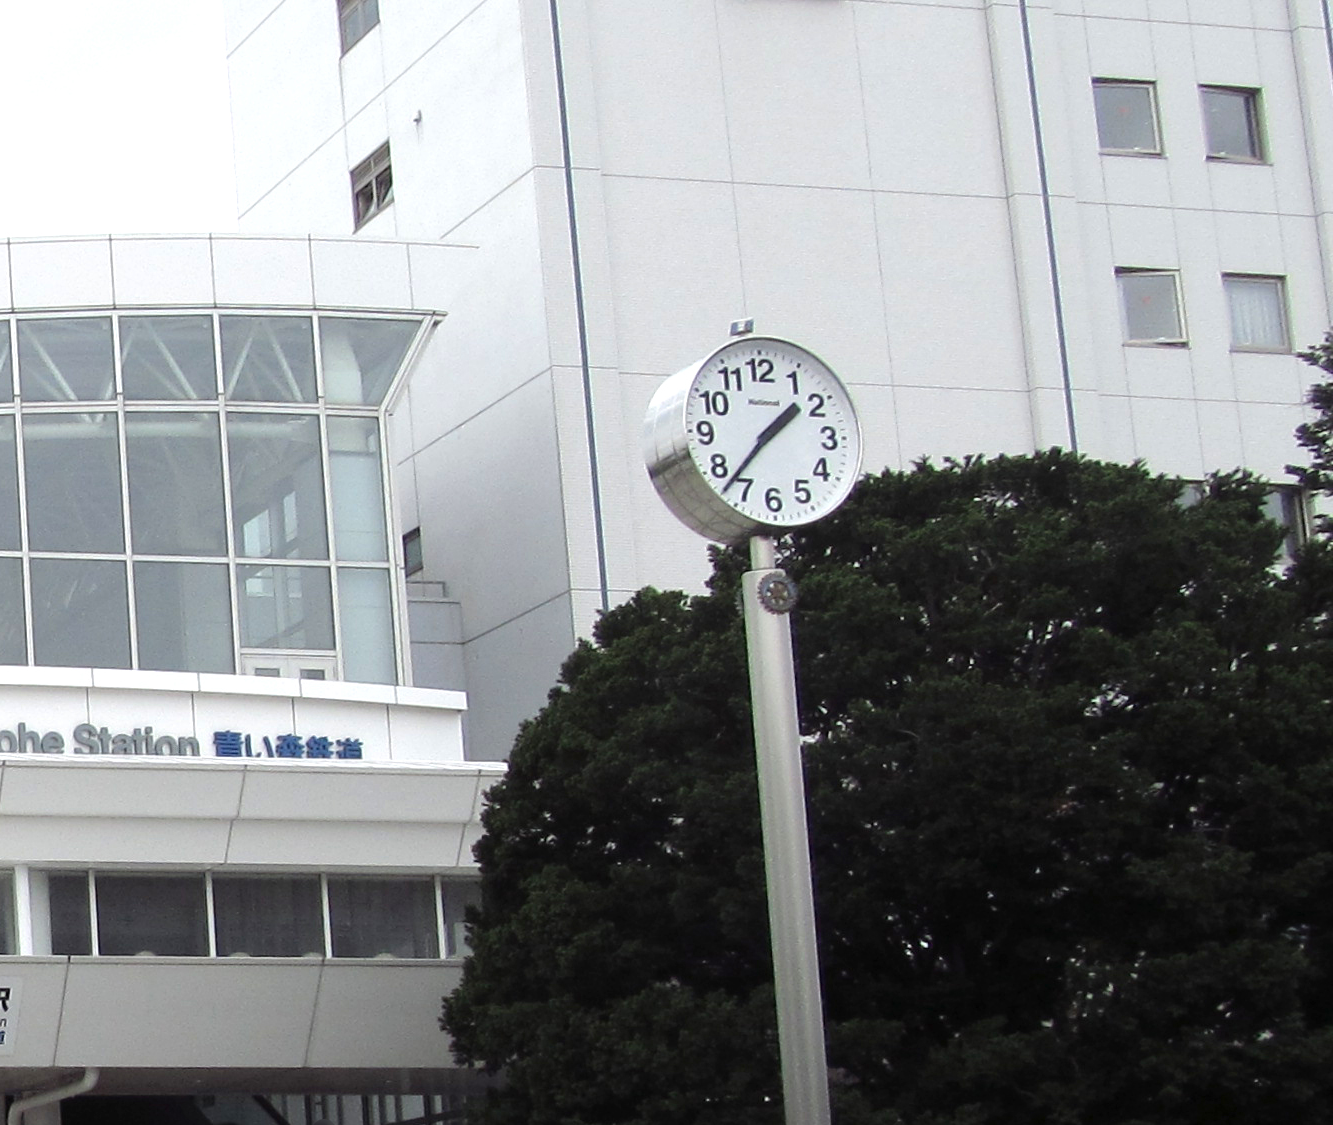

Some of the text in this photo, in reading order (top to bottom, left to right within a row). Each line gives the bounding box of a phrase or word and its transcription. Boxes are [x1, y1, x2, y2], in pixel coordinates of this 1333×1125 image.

[718, 367, 743, 391] 11
[745, 358, 775, 383] 12
[786, 371, 799, 395] 1
[699, 391, 729, 416] 10
[807, 394, 826, 418] 2
[696, 421, 715, 445] 9
[820, 426, 838, 451] 3
[710, 454, 728, 478] 8
[813, 458, 831, 482] 4
[736, 478, 754, 502] 7
[765, 488, 783, 513] 6
[794, 480, 811, 504] 5
[73, 723, 200, 756] Station
[213, 730, 364, 758] 青い森鉄道
